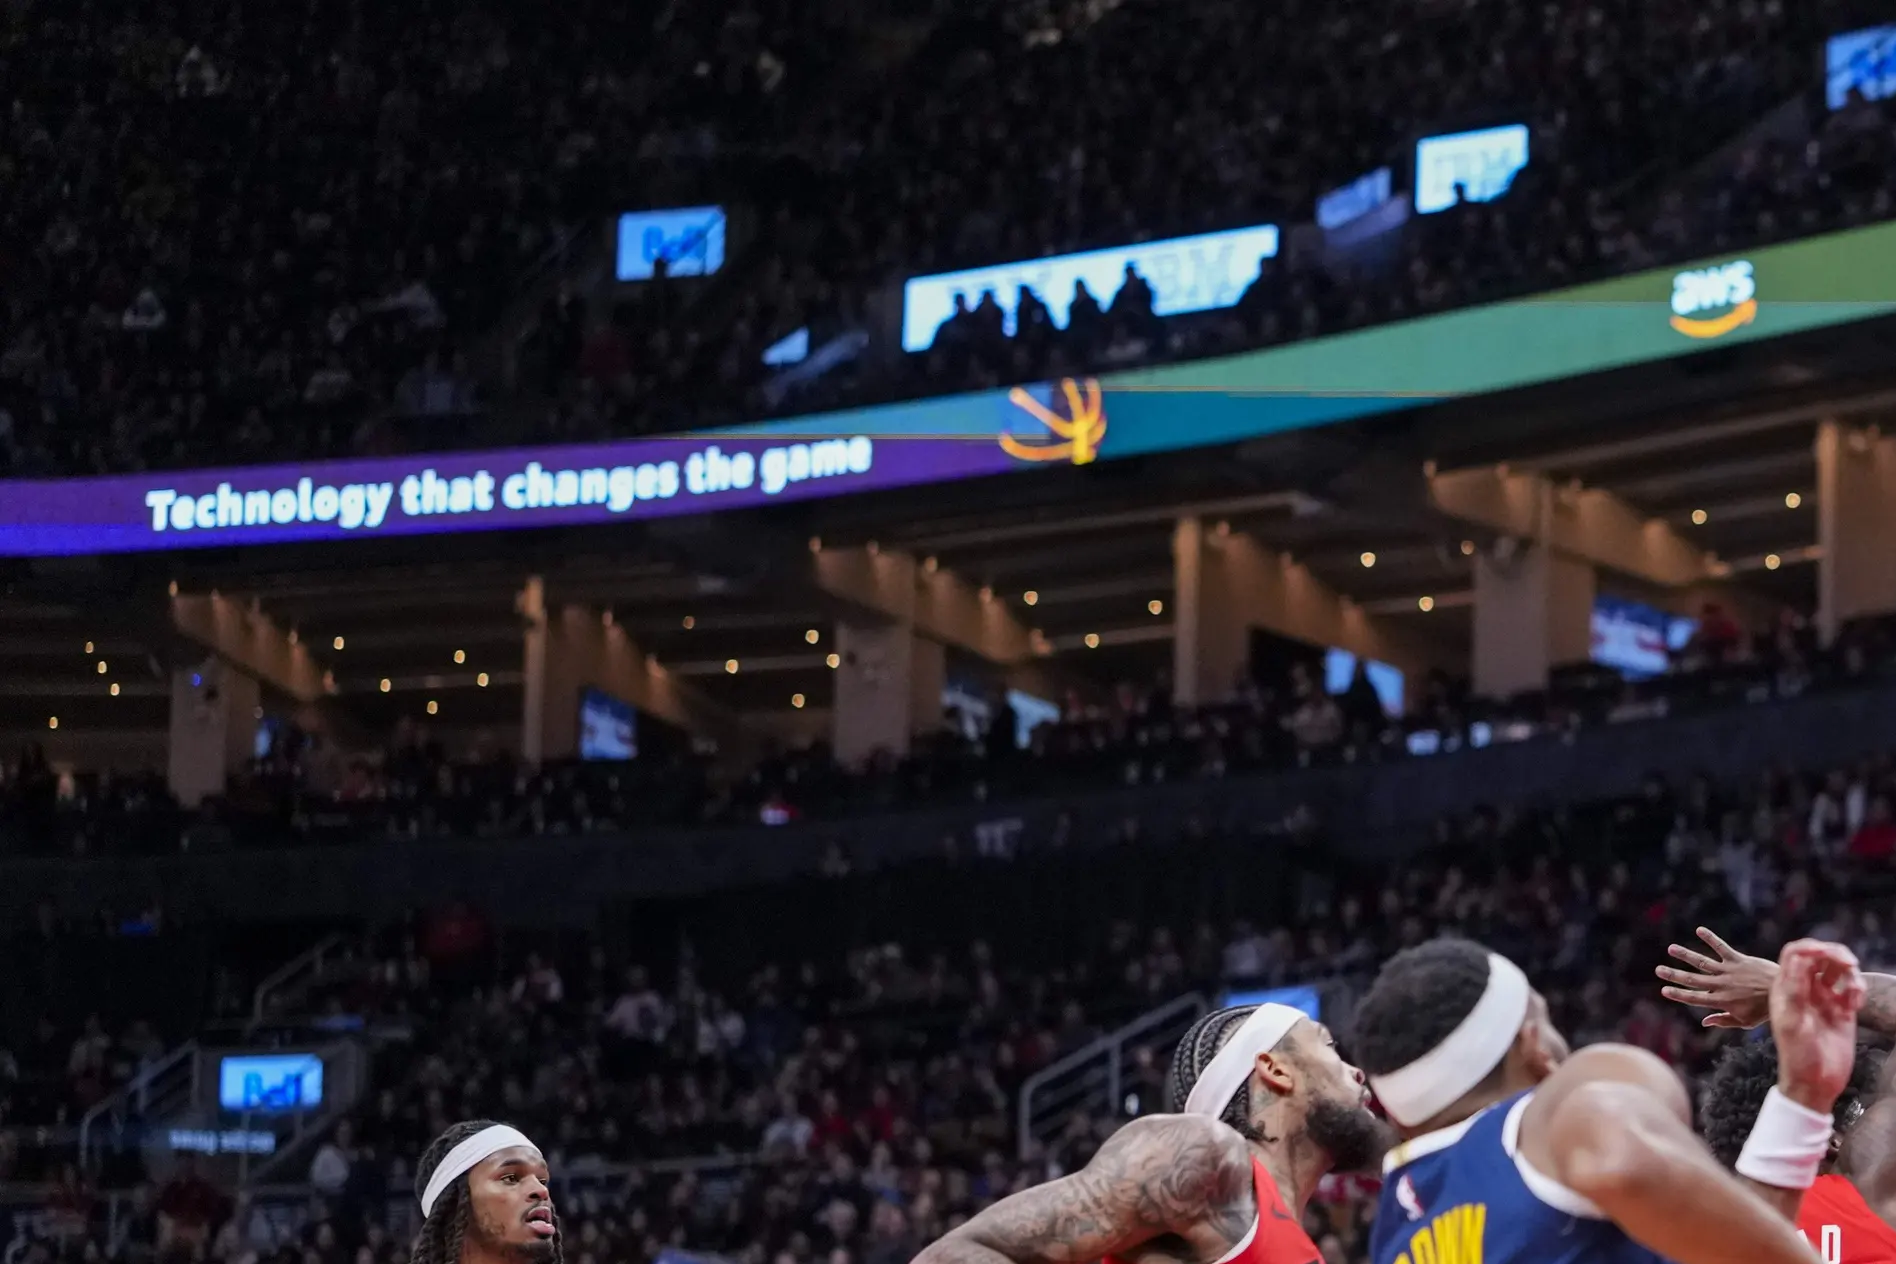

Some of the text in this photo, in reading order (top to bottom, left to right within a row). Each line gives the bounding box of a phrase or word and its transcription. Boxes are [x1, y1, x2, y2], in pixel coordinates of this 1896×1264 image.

[1670, 260, 1756, 315] aws
[145, 434, 873, 532] Technology that changes the game
